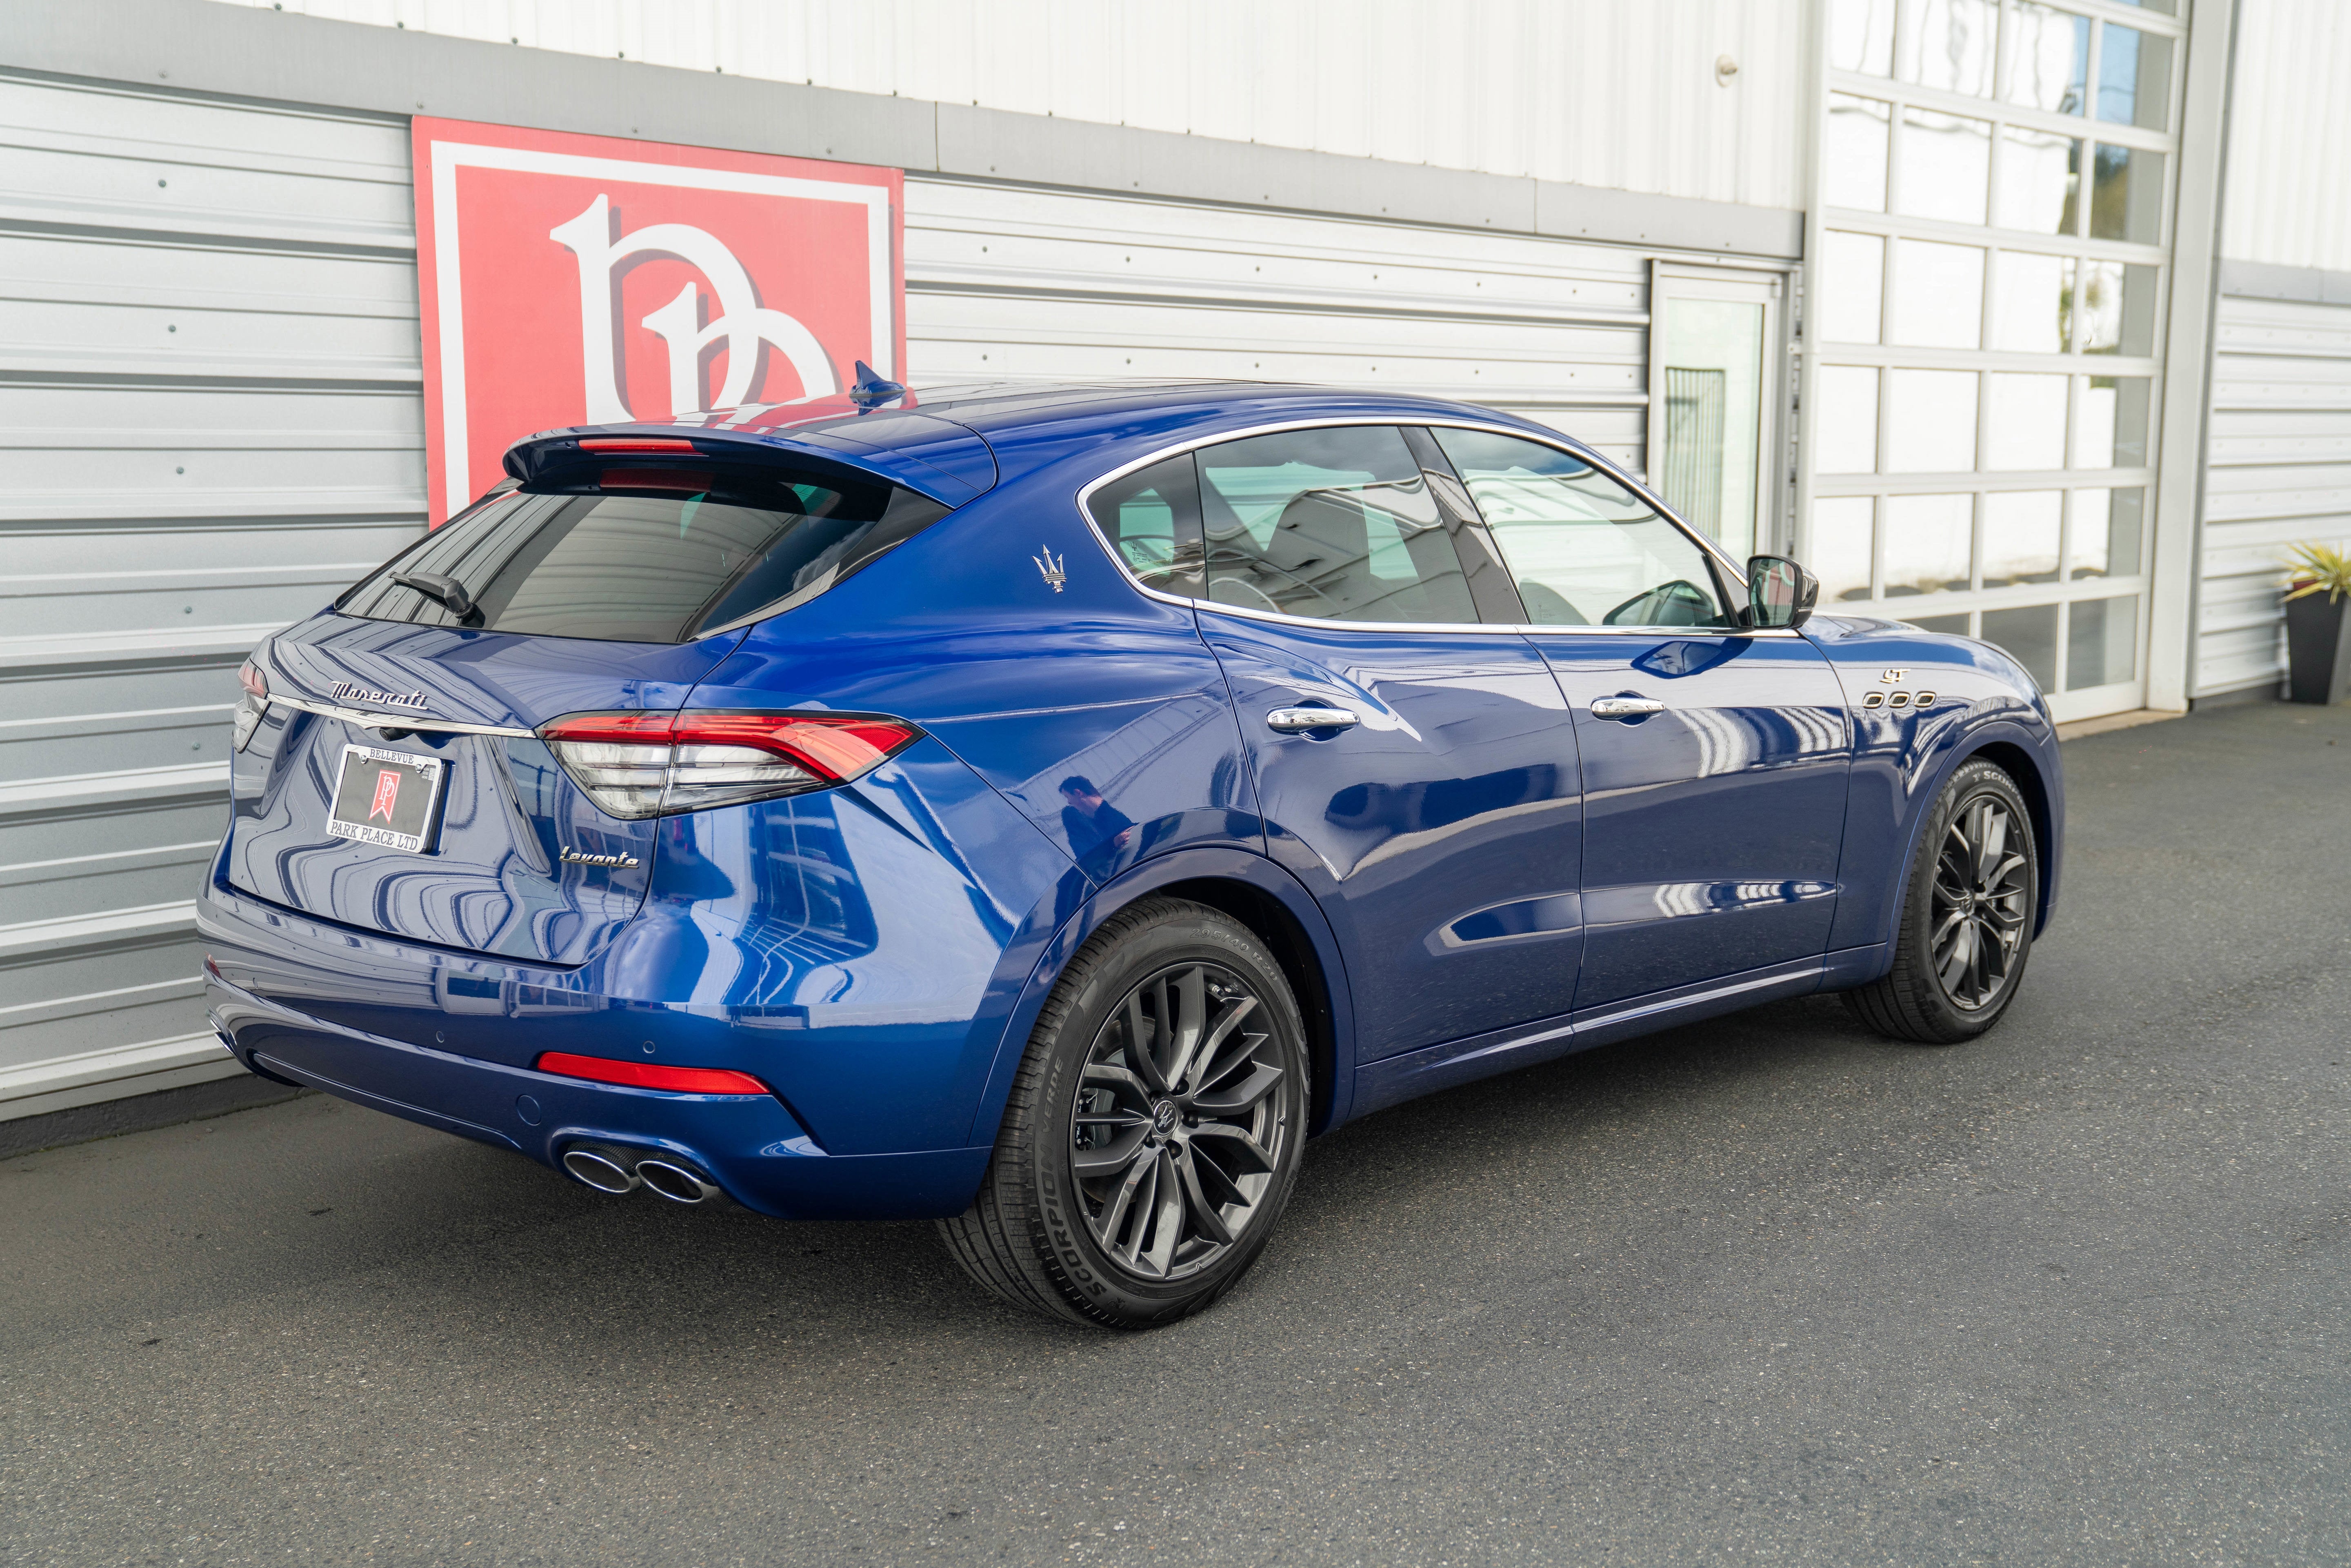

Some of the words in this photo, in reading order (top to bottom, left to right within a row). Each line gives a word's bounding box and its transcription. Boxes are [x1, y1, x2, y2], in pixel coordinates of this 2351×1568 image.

[1879, 669, 1911, 683] GT
[330, 681, 429, 710] Maserati
[369, 748, 414, 764] BELLEVUE
[330, 822, 358, 838] PARK
[360, 828, 394, 848] PLACE
[397, 835, 418, 851] LTD
[559, 846, 640, 869] Levante
[1189, 928, 1249, 952] 295/40
[1251, 952, 1278, 981] R20
[1042, 1056, 1063, 1133] VERDE
[1040, 1144, 1107, 1297] SCORPION
